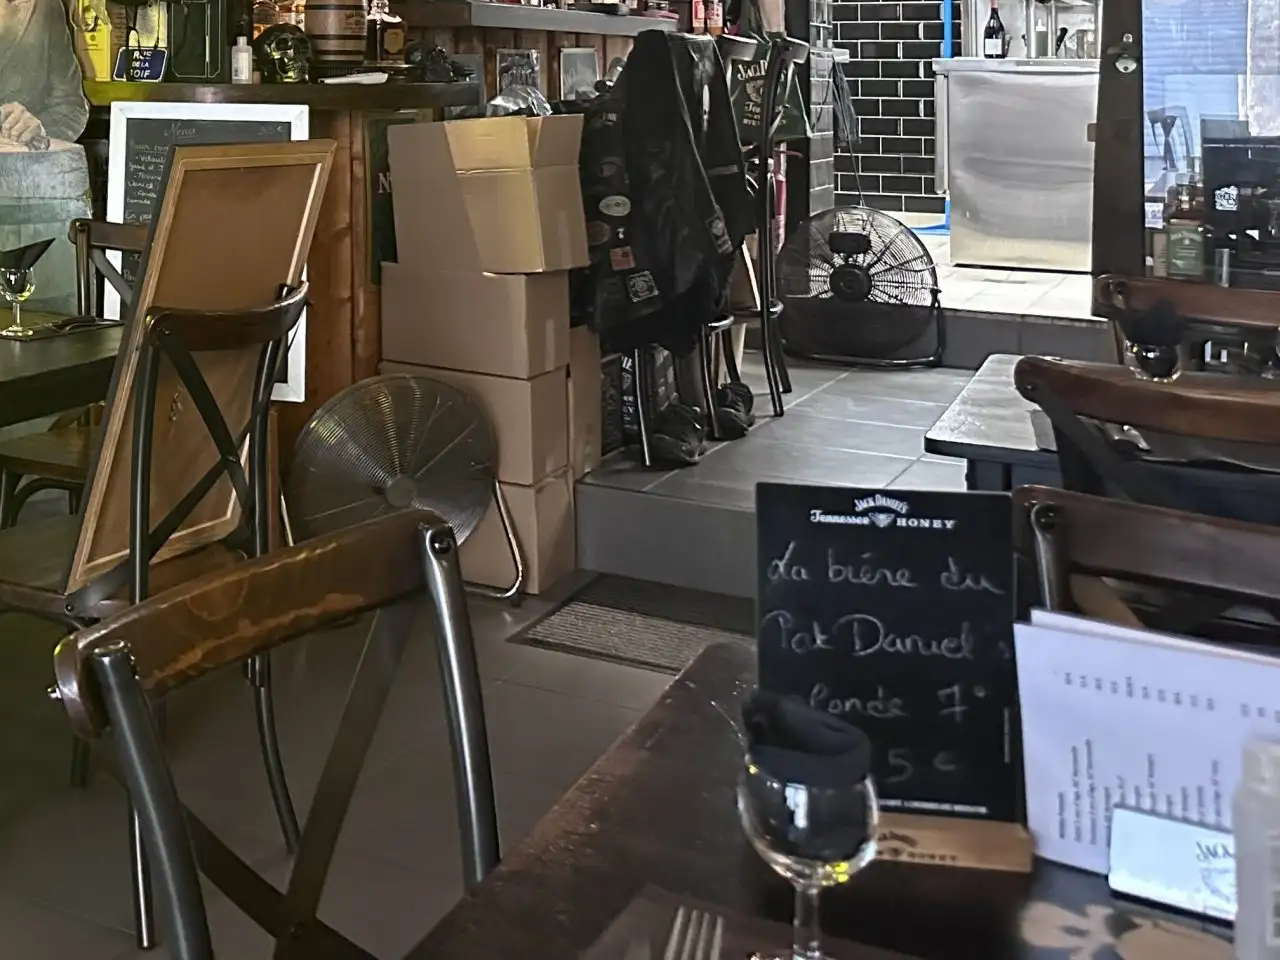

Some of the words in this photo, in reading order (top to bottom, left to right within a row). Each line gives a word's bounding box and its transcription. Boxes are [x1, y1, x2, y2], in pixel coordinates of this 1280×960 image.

[854, 495, 875, 513] JACK
[873, 494, 910, 514] DANIEL'S
[810, 509, 870, 525] Tennessee
[896, 517, 957, 529] HONEY
[939, 555, 1006, 595] du
[886, 747, 914, 784] 5
